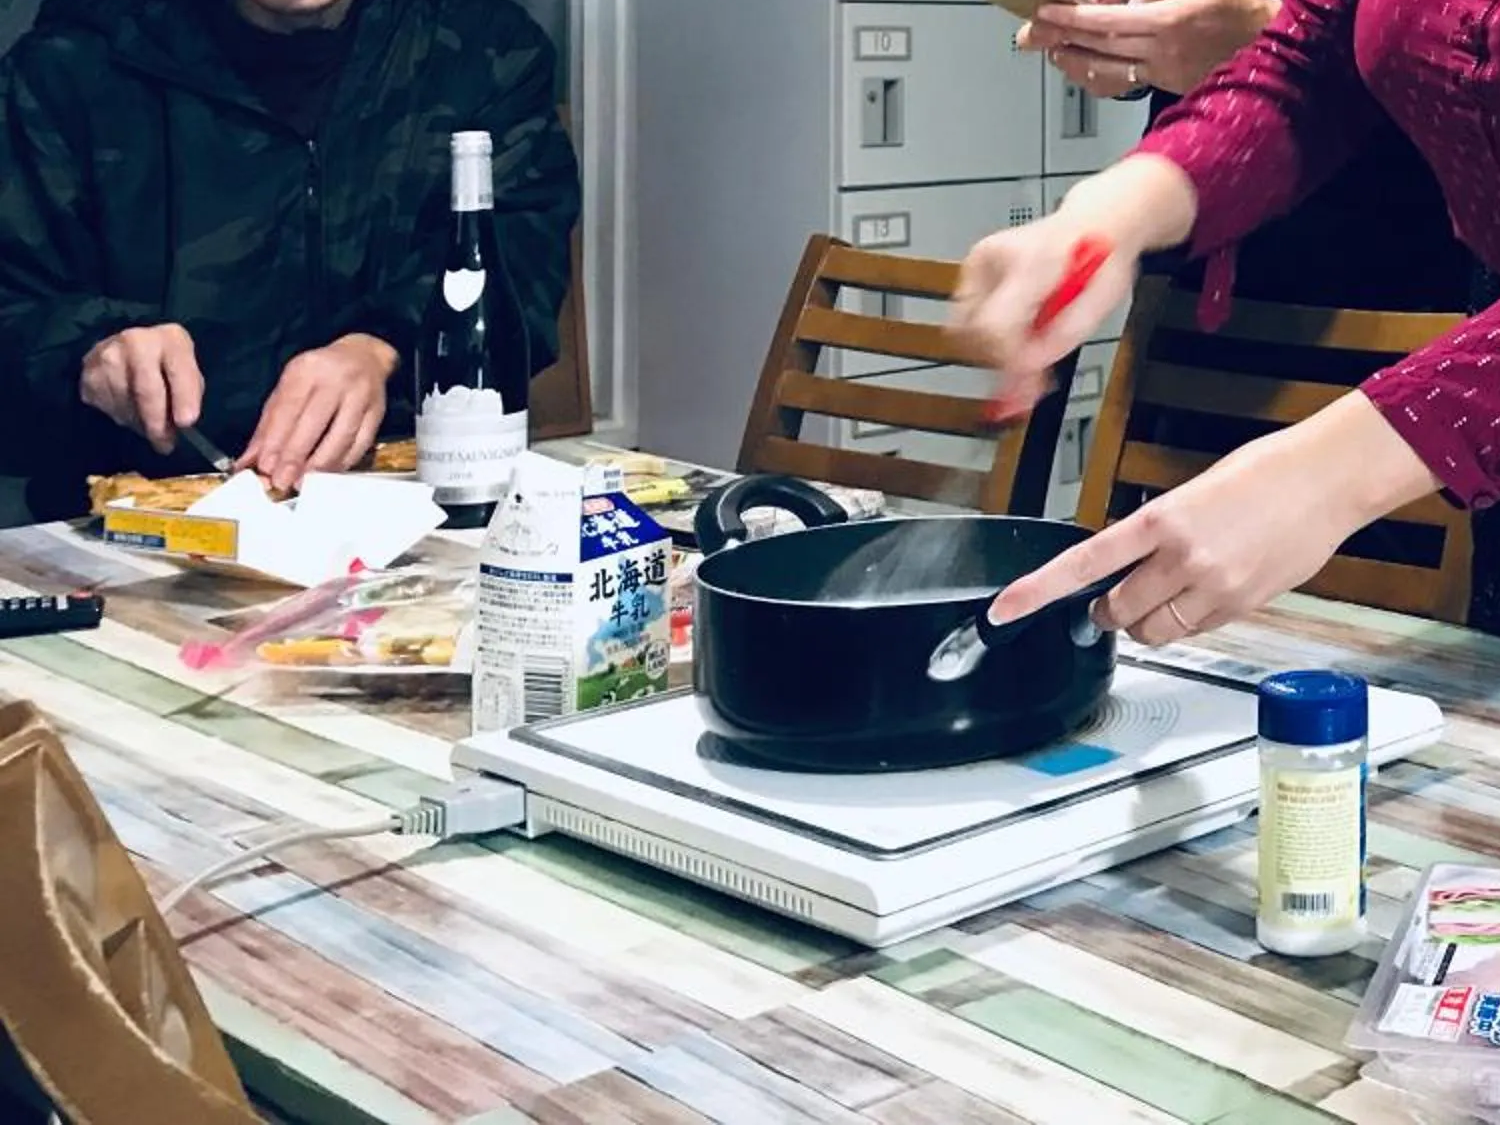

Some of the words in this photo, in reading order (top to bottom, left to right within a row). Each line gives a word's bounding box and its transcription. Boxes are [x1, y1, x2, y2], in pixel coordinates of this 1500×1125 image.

[874, 31, 891, 52] 10
[589, 549, 668, 601] 北海道
[610, 593, 650, 625] 牛乳
